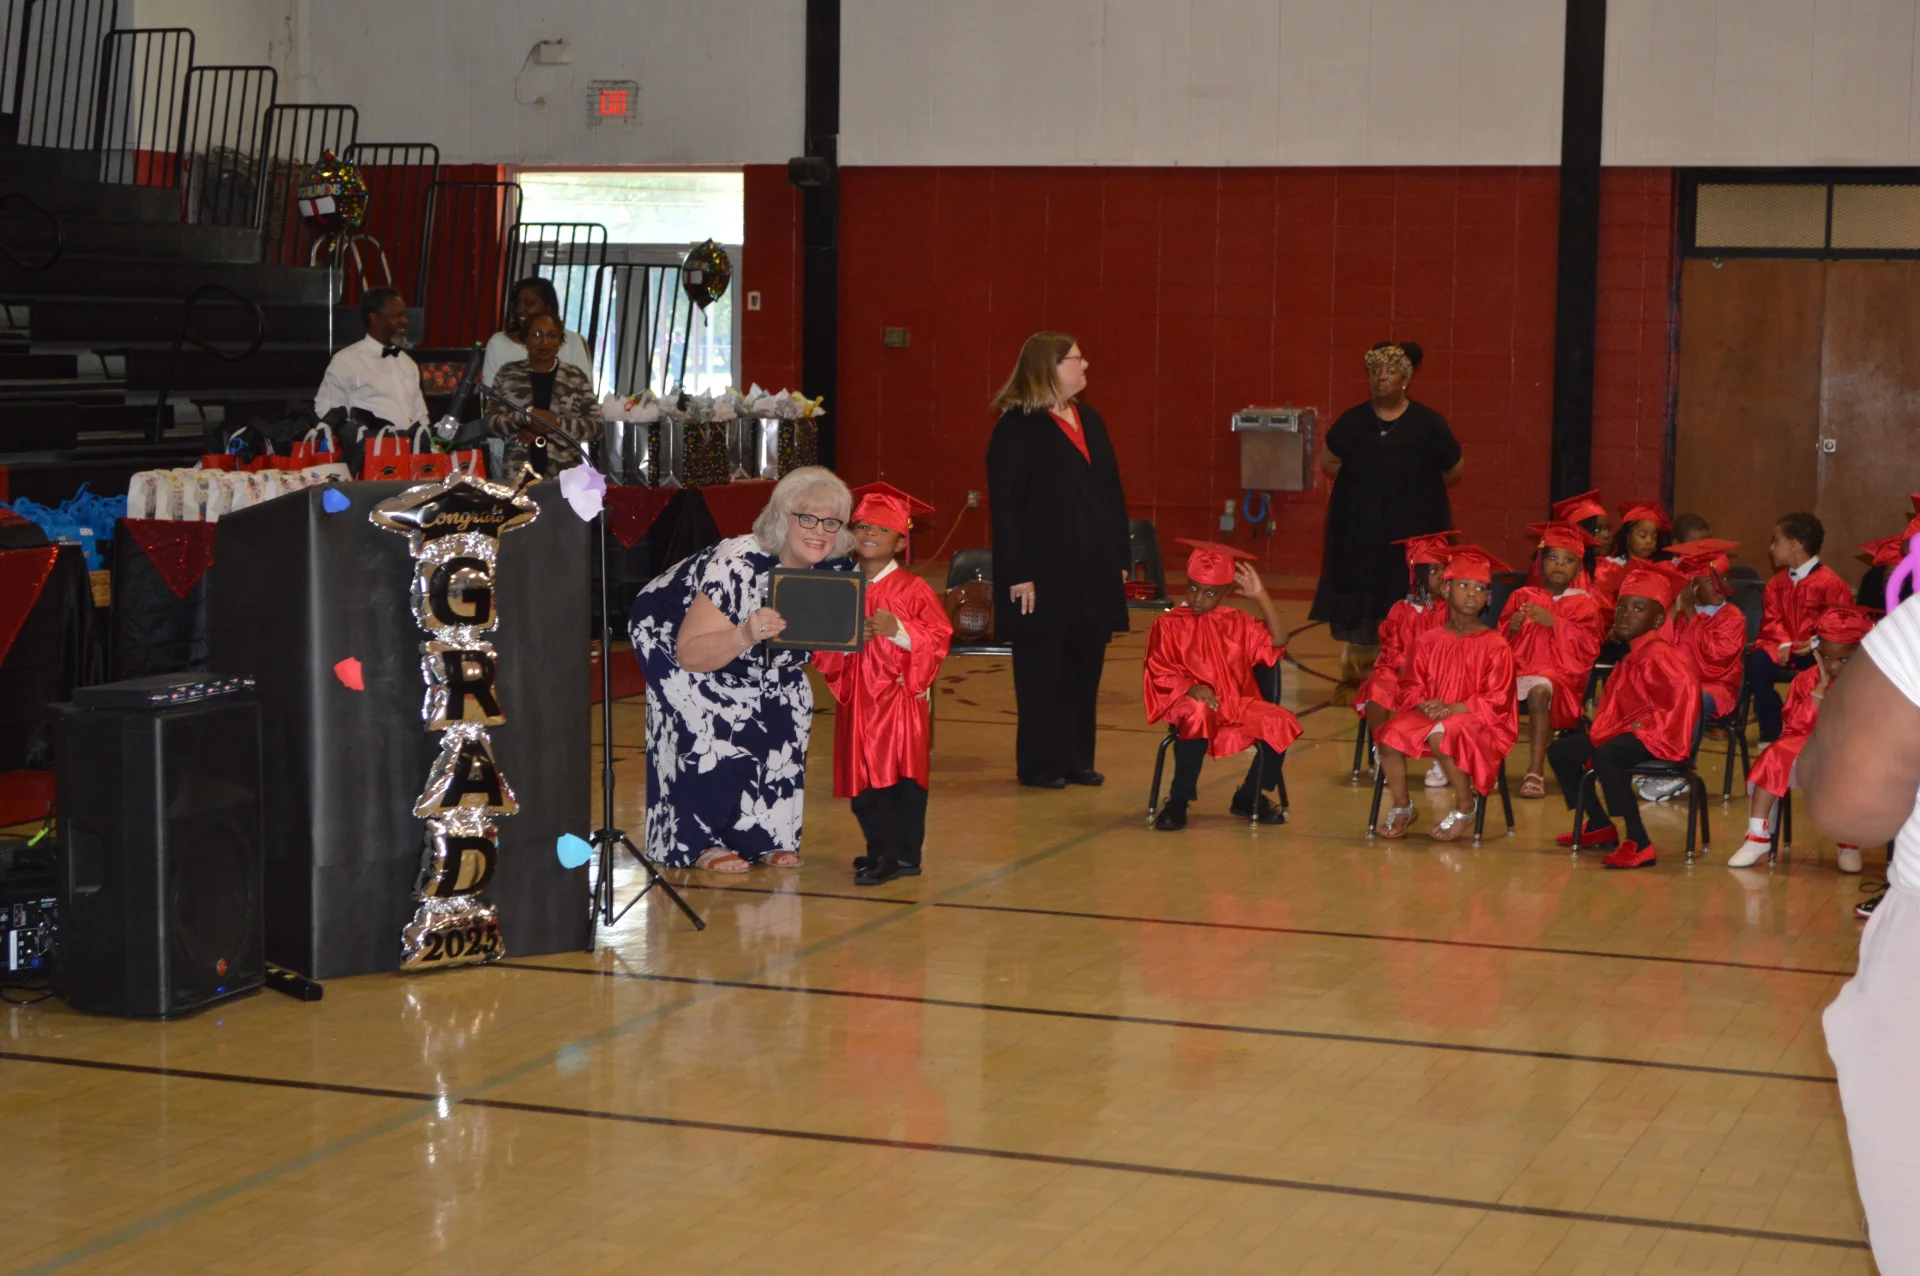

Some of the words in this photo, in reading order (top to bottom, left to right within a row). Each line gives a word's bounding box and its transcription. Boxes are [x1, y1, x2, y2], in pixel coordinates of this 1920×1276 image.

[600, 90, 627, 115] EXIT
[428, 556, 504, 898] GRAD
[422, 925, 498, 961] 2025
